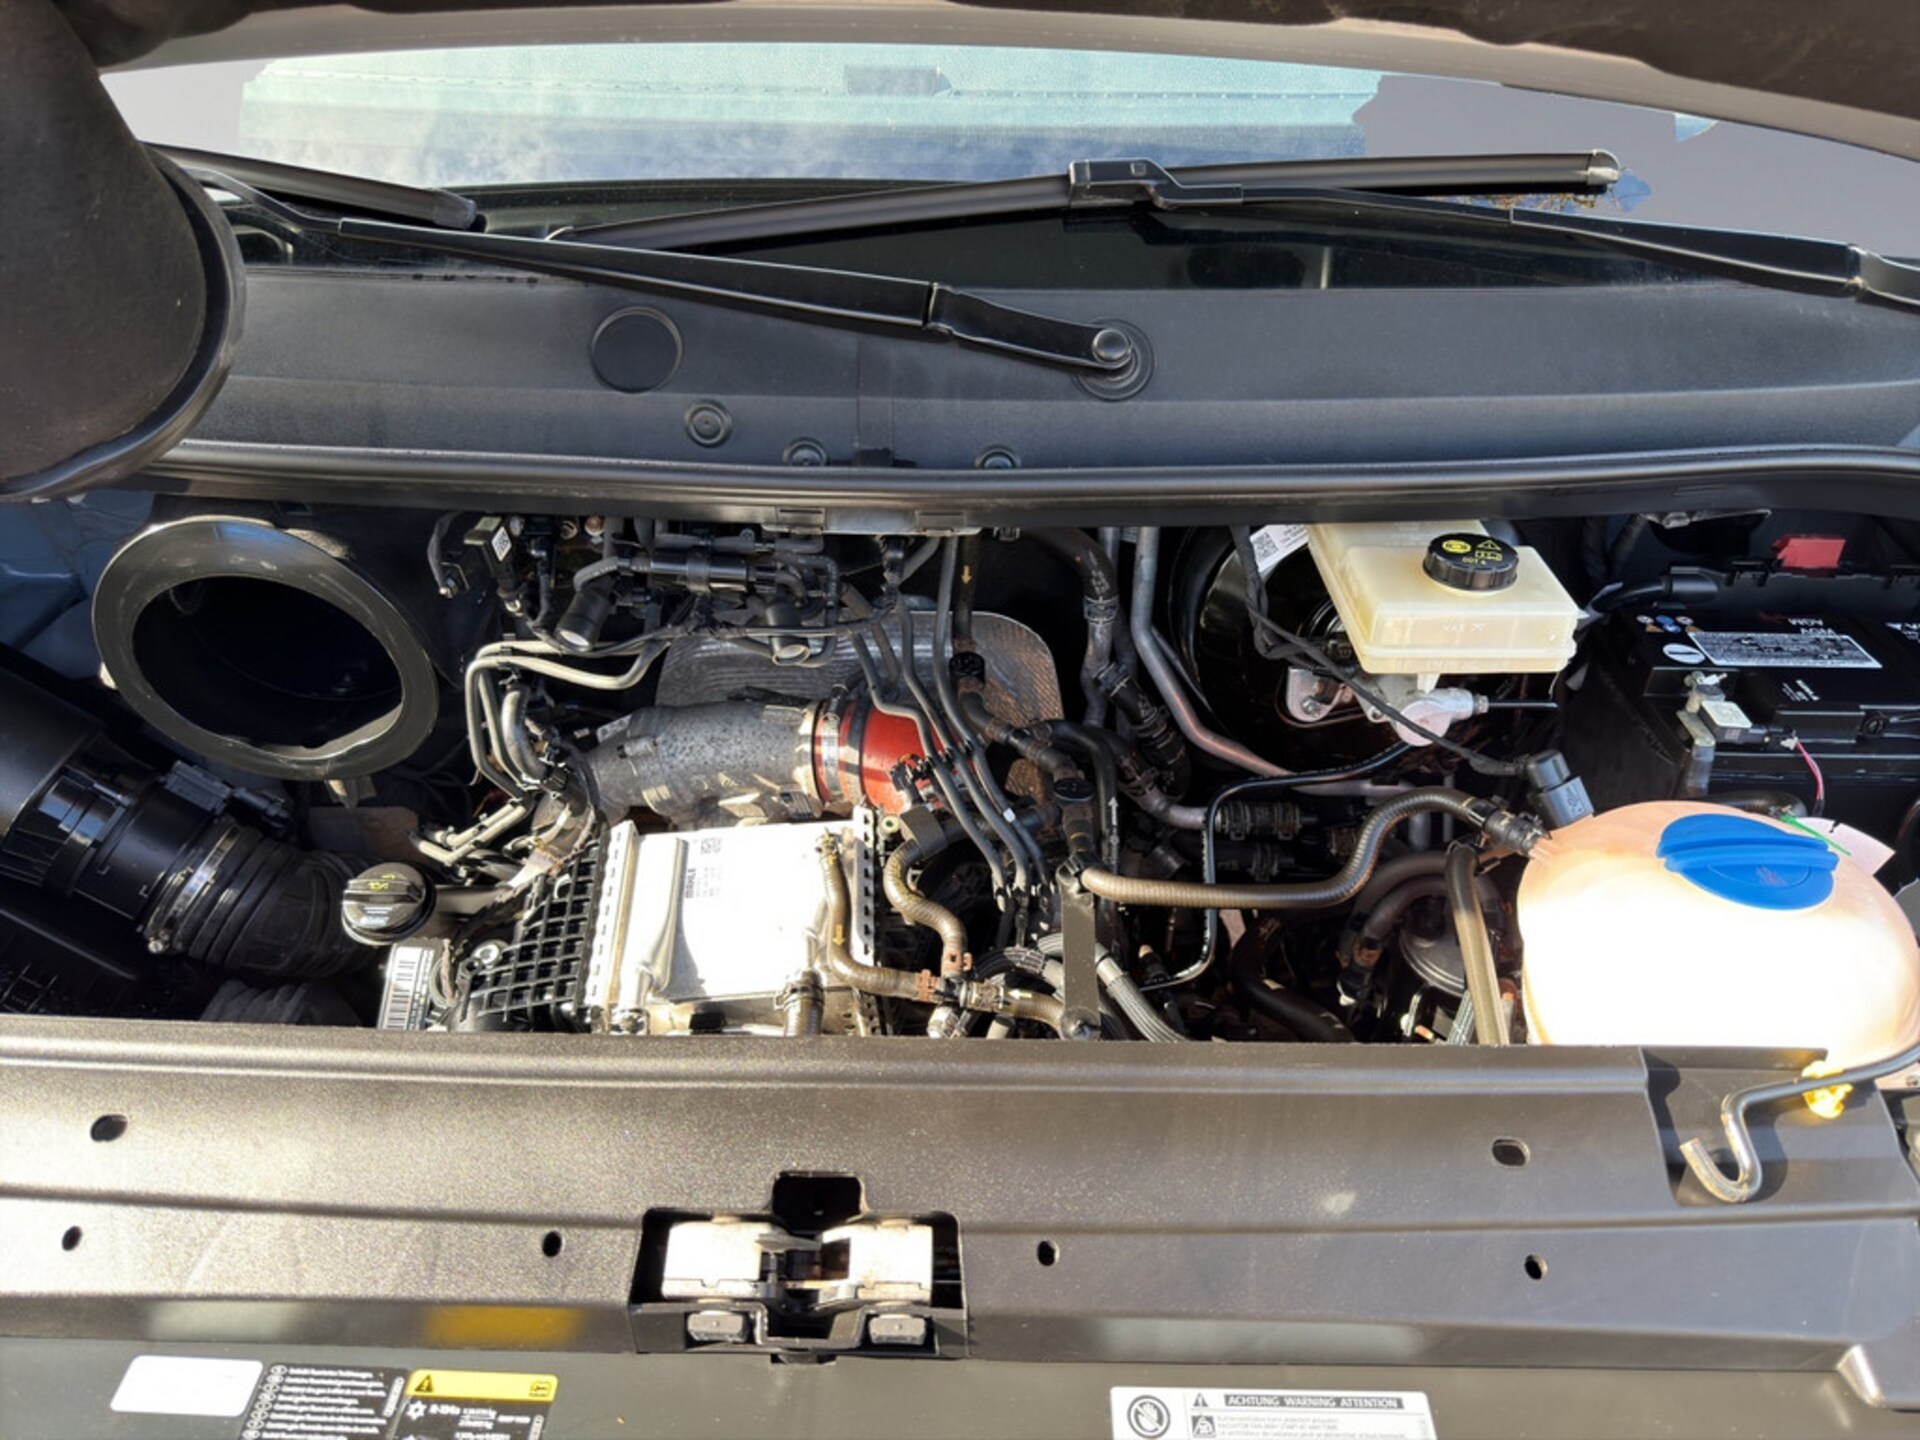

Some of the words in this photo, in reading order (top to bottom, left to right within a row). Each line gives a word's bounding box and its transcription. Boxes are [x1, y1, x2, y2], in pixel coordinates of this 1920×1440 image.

[1228, 1395, 1280, 1407] ACHTUNG
[1284, 1396, 1336, 1408] WARNING
[1340, 1397, 1398, 1409] ATTENTION
